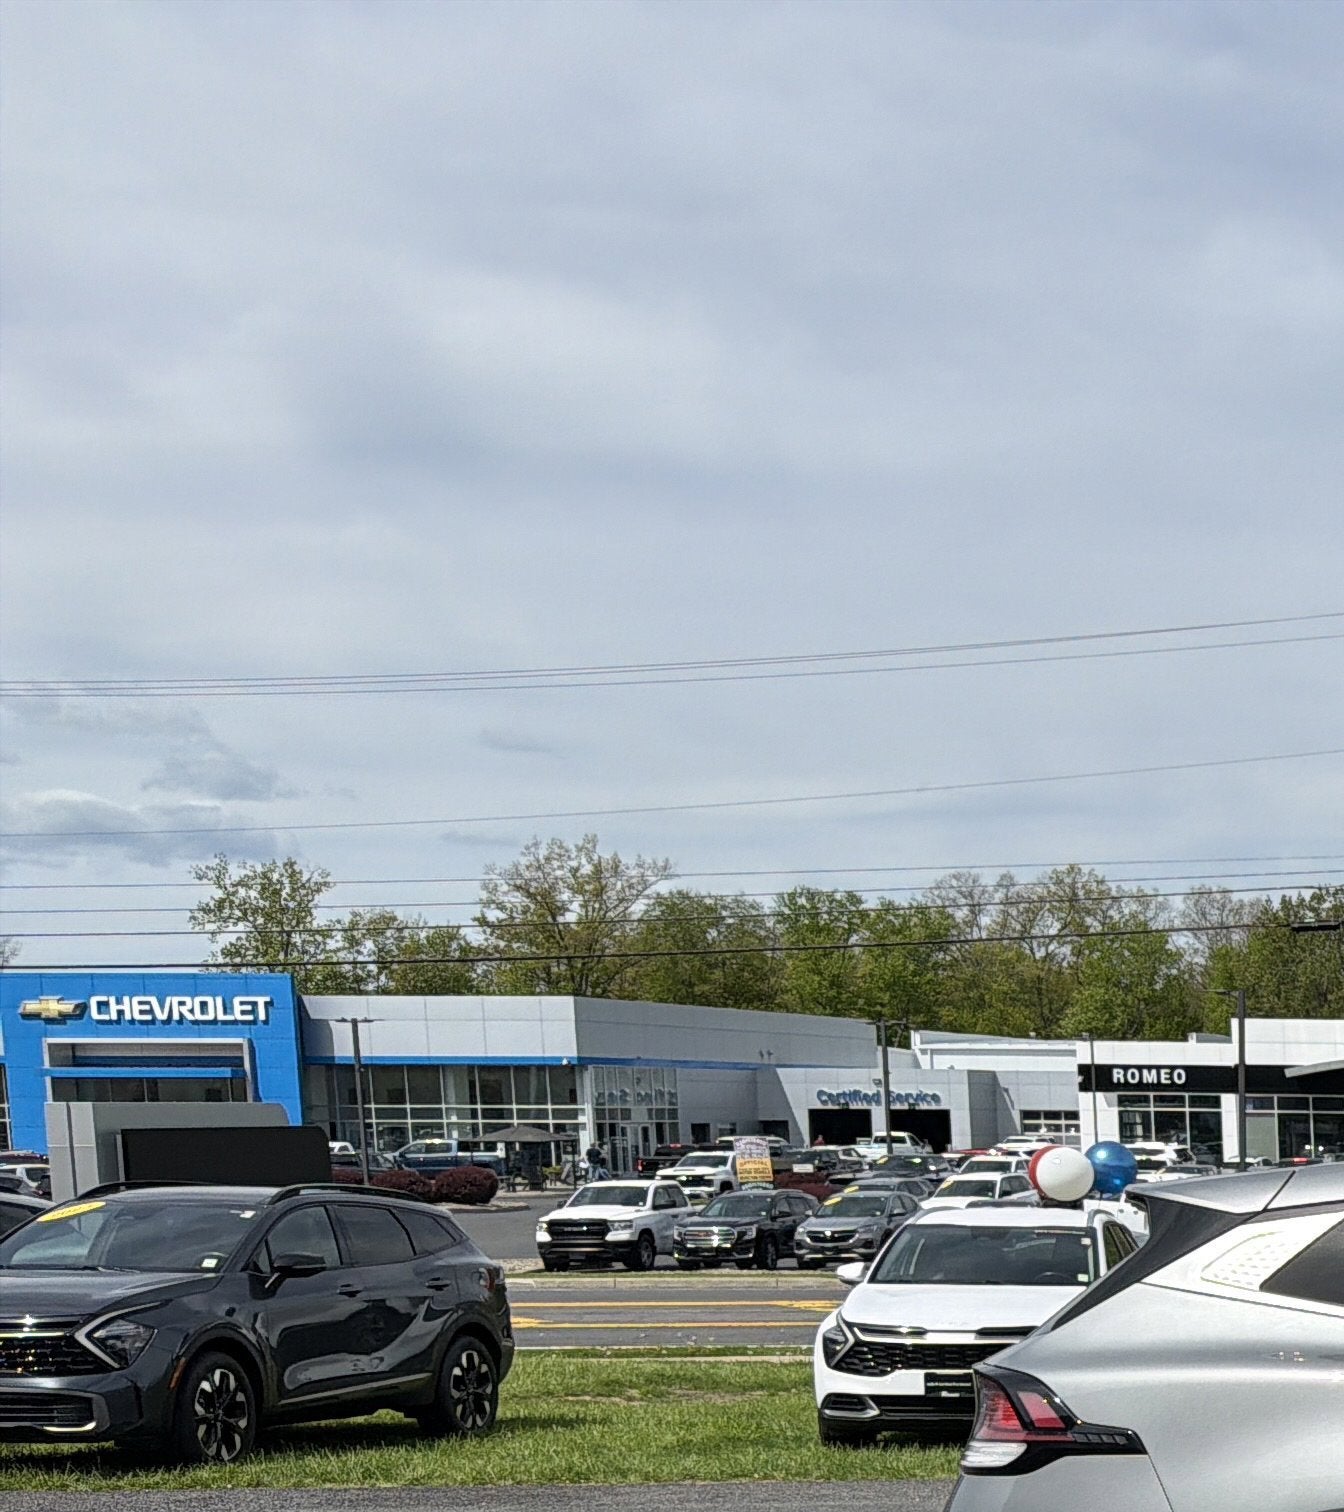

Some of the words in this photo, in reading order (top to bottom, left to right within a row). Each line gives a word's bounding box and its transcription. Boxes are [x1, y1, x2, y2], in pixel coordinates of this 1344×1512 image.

[90, 996, 271, 1021] CHEVROLET
[1112, 1068, 1186, 1084] ROMEO
[816, 1089, 882, 1106] Certified
[889, 1089, 941, 1106] Service
